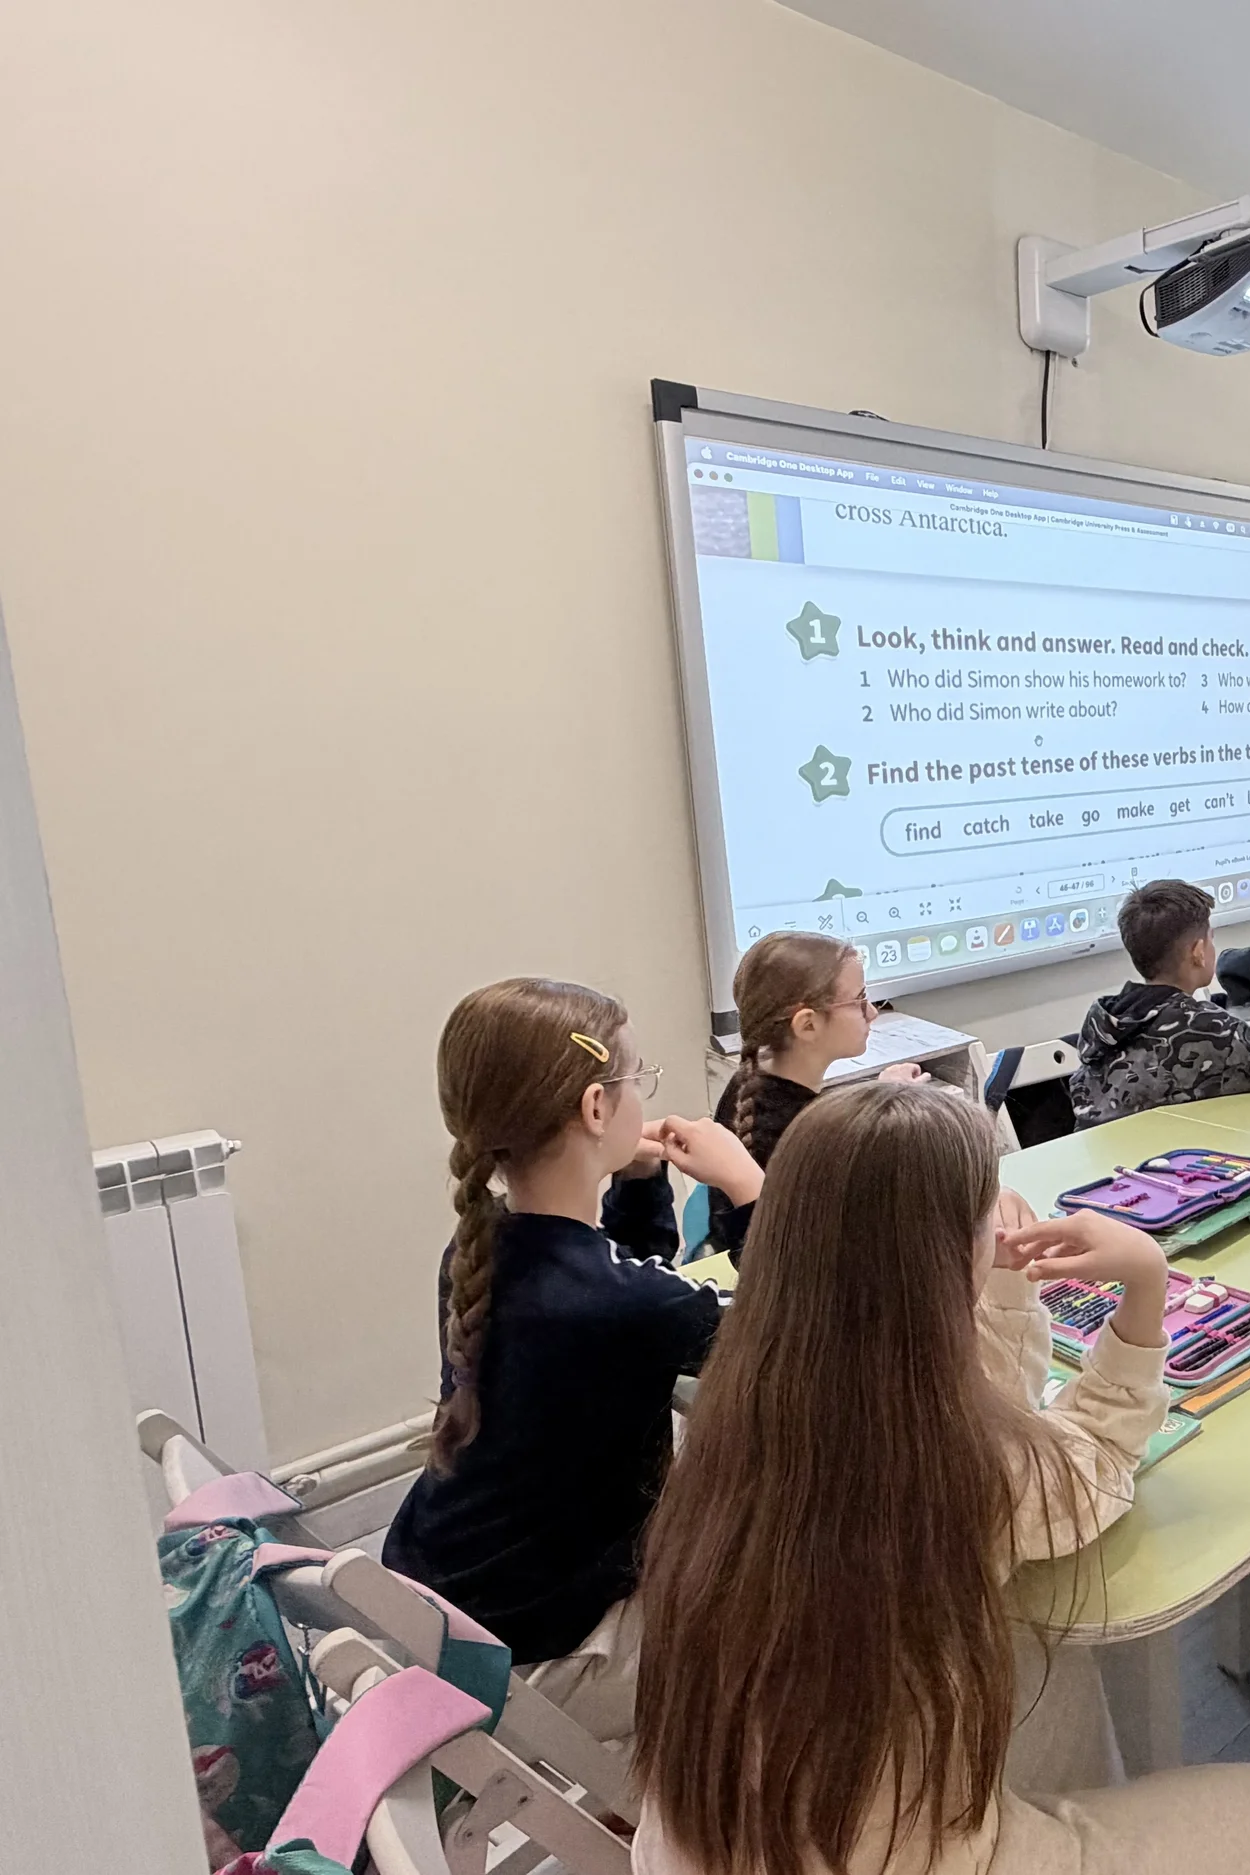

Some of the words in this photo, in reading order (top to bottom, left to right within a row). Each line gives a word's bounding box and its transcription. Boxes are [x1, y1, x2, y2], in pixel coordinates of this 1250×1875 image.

[726, 452, 777, 468] Cambridge
[779, 460, 797, 470] One
[799, 463, 835, 476] Desktop
[836, 468, 854, 479] App
[866, 472, 880, 482] File
[891, 476, 906, 486] Edit
[917, 480, 935, 490] View
[945, 483, 973, 495] Window
[982, 488, 999, 499] Help
[835, 503, 893, 525] cross
[898, 509, 1008, 538] Antarctica.
[950, 503, 989, 515] Cambridge
[990, 508, 1004, 516] One
[1005, 510, 1032, 520] Desktop
[1033, 514, 1046, 523] App
[1050, 516, 1084, 528] Cambridge
[1084, 520, 1114, 532] University
[1115, 524, 1130, 533] Press
[808, 618, 826, 644] 1
[857, 625, 926, 654] Look,
[931, 628, 992, 652] think
[997, 632, 1036, 652] and
[1042, 635, 1116, 654] answer.
[1121, 636, 1164, 655] Read
[1168, 638, 1198, 656] and
[1202, 638, 1250, 658] check.
[860, 670, 871, 688] 1
[888, 668, 930, 688] Who
[935, 669, 962, 688] did
[968, 670, 1020, 688] Simon
[1024, 669, 1065, 688] show
[1069, 670, 1090, 688] his
[1094, 671, 1166, 688] homework
[1168, 672, 1187, 688] to?
[1201, 674, 1208, 688] 3
[1218, 672, 1244, 688] Who
[862, 705, 874, 722] 2
[890, 703, 932, 722] Who
[936, 702, 964, 721] did
[969, 702, 1022, 720] Simon
[1026, 701, 1064, 719] write
[1068, 700, 1118, 718] about?
[1201, 700, 1209, 714] 4
[1219, 700, 1244, 714] How
[819, 762, 838, 786] 2
[867, 760, 919, 784] Find
[926, 760, 963, 782] the
[969, 757, 1016, 784] past
[1021, 756, 1074, 775] tense
[1079, 751, 1098, 772] of
[1102, 750, 1149, 770] these
[1153, 746, 1197, 766] verbs
[1200, 744, 1214, 763] in
[1218, 744, 1242, 762] the
[905, 821, 942, 842] find
[963, 814, 1010, 836] catch
[1029, 810, 1064, 829] take
[1082, 808, 1100, 826] go
[1117, 801, 1154, 820] make
[1170, 798, 1191, 817] get
[1204, 792, 1234, 810] can't
[1086, 880, 1094, 888] 96
[881, 950, 898, 963] 23
